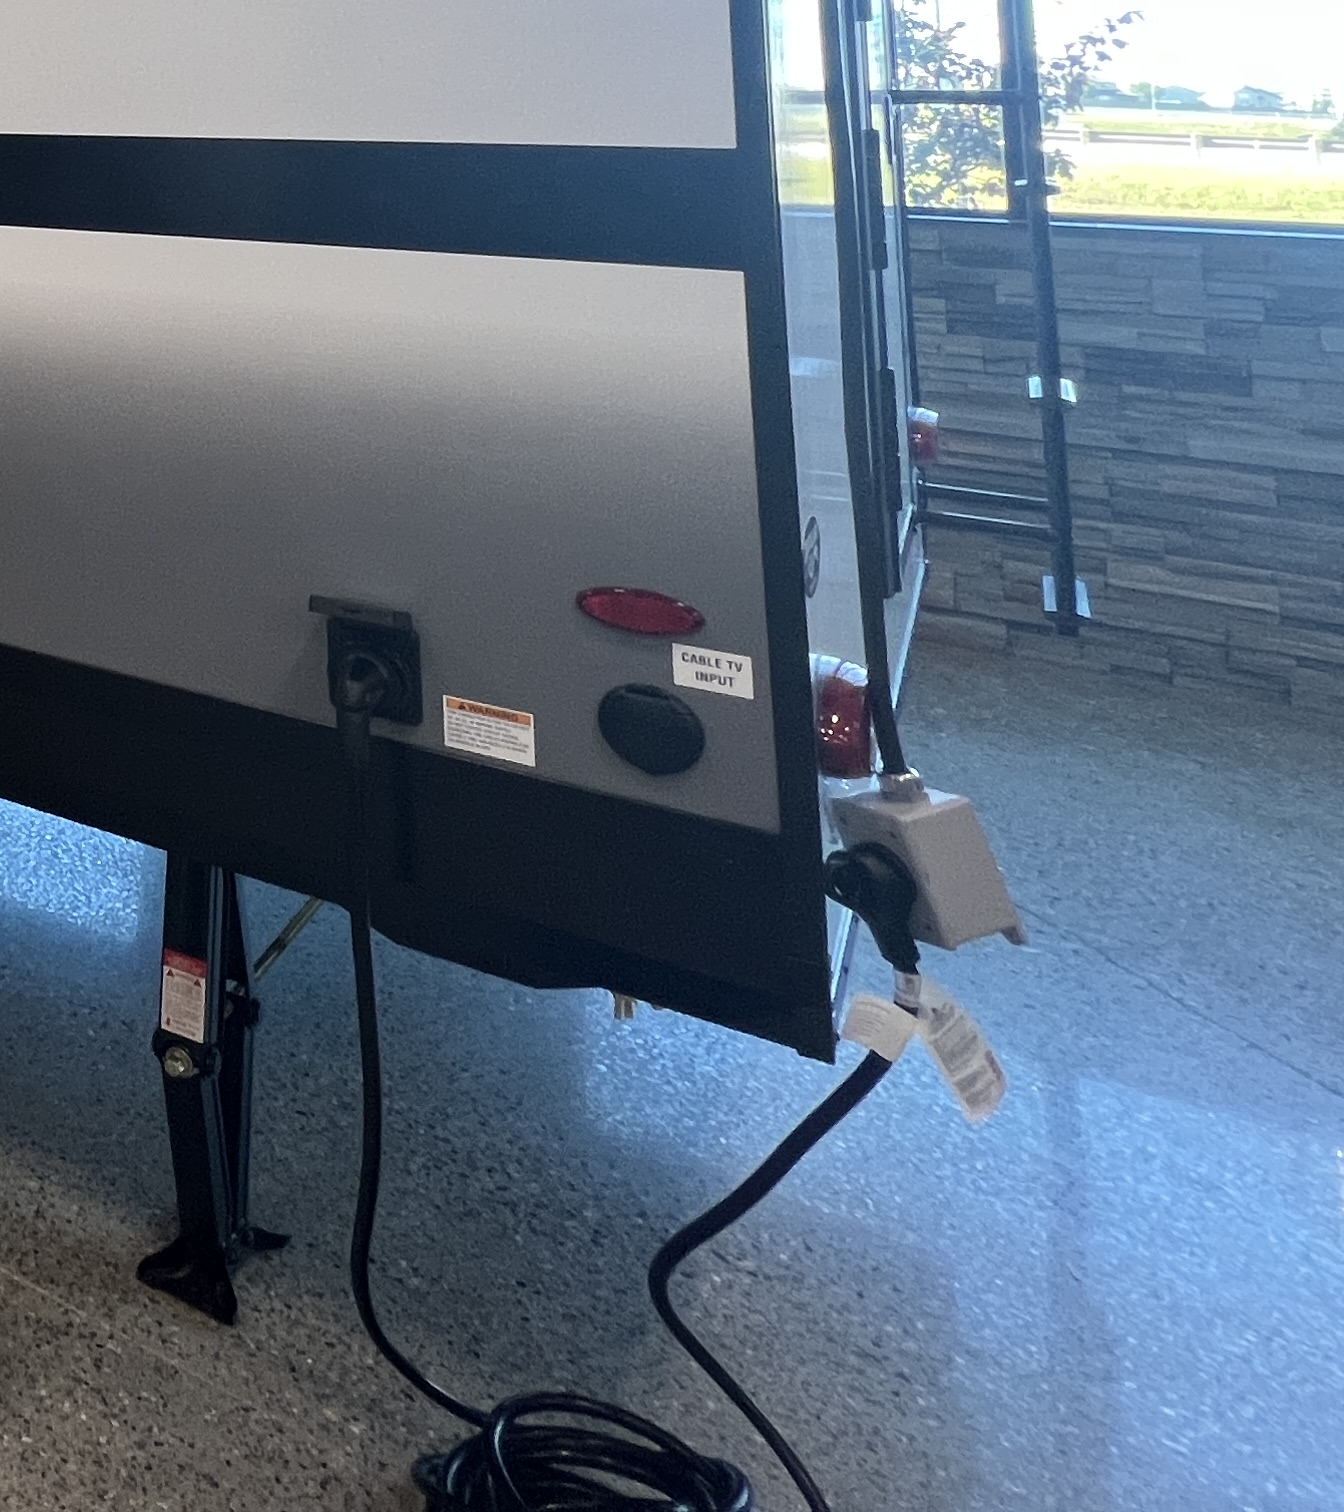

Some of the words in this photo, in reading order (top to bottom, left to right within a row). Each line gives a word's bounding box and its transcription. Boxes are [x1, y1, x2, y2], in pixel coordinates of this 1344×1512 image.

[681, 652, 722, 669] CABLE
[726, 660, 743, 672] TV
[695, 671, 735, 688] INPUT
[468, 704, 519, 722] WARNING
